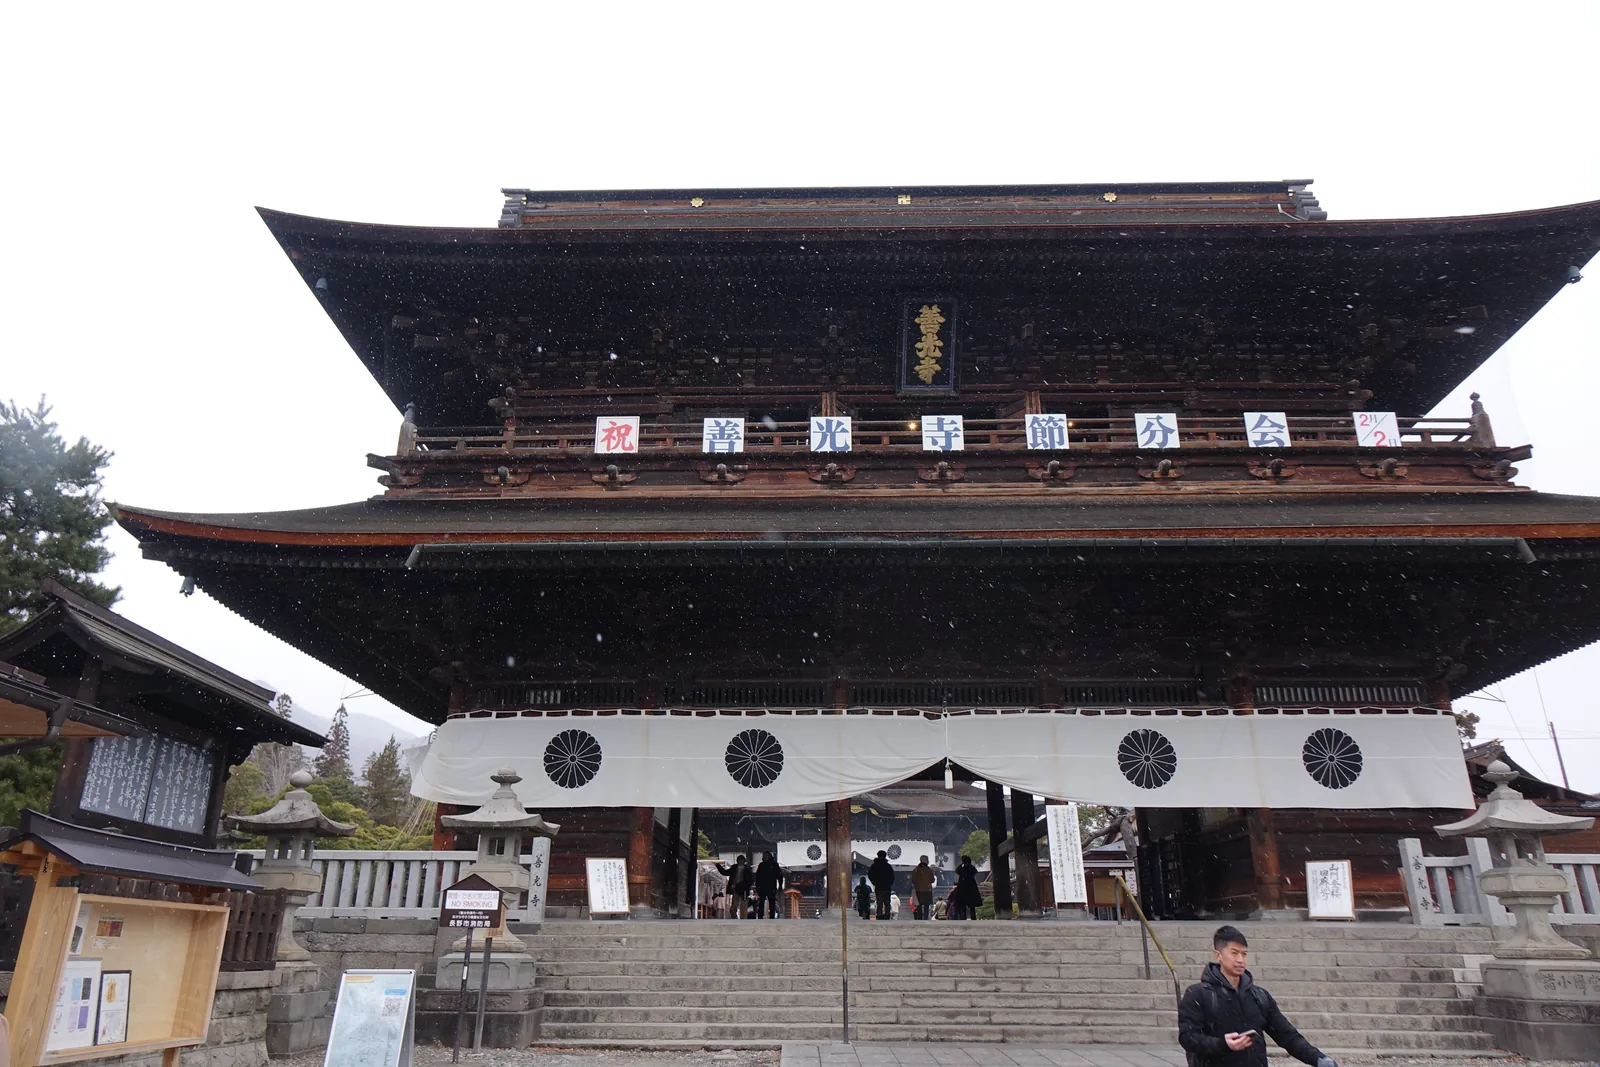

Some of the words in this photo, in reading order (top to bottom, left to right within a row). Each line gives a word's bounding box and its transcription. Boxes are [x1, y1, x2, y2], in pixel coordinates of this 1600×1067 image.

[914, 304, 946, 384] 善光寺
[600, 420, 635, 452] 祝
[531, 854, 544, 907] 善光寺
[1411, 855, 1431, 910] 善光寺
[449, 919, 491, 928] 長野市消防局
[463, 900, 493, 908] SMOKING
